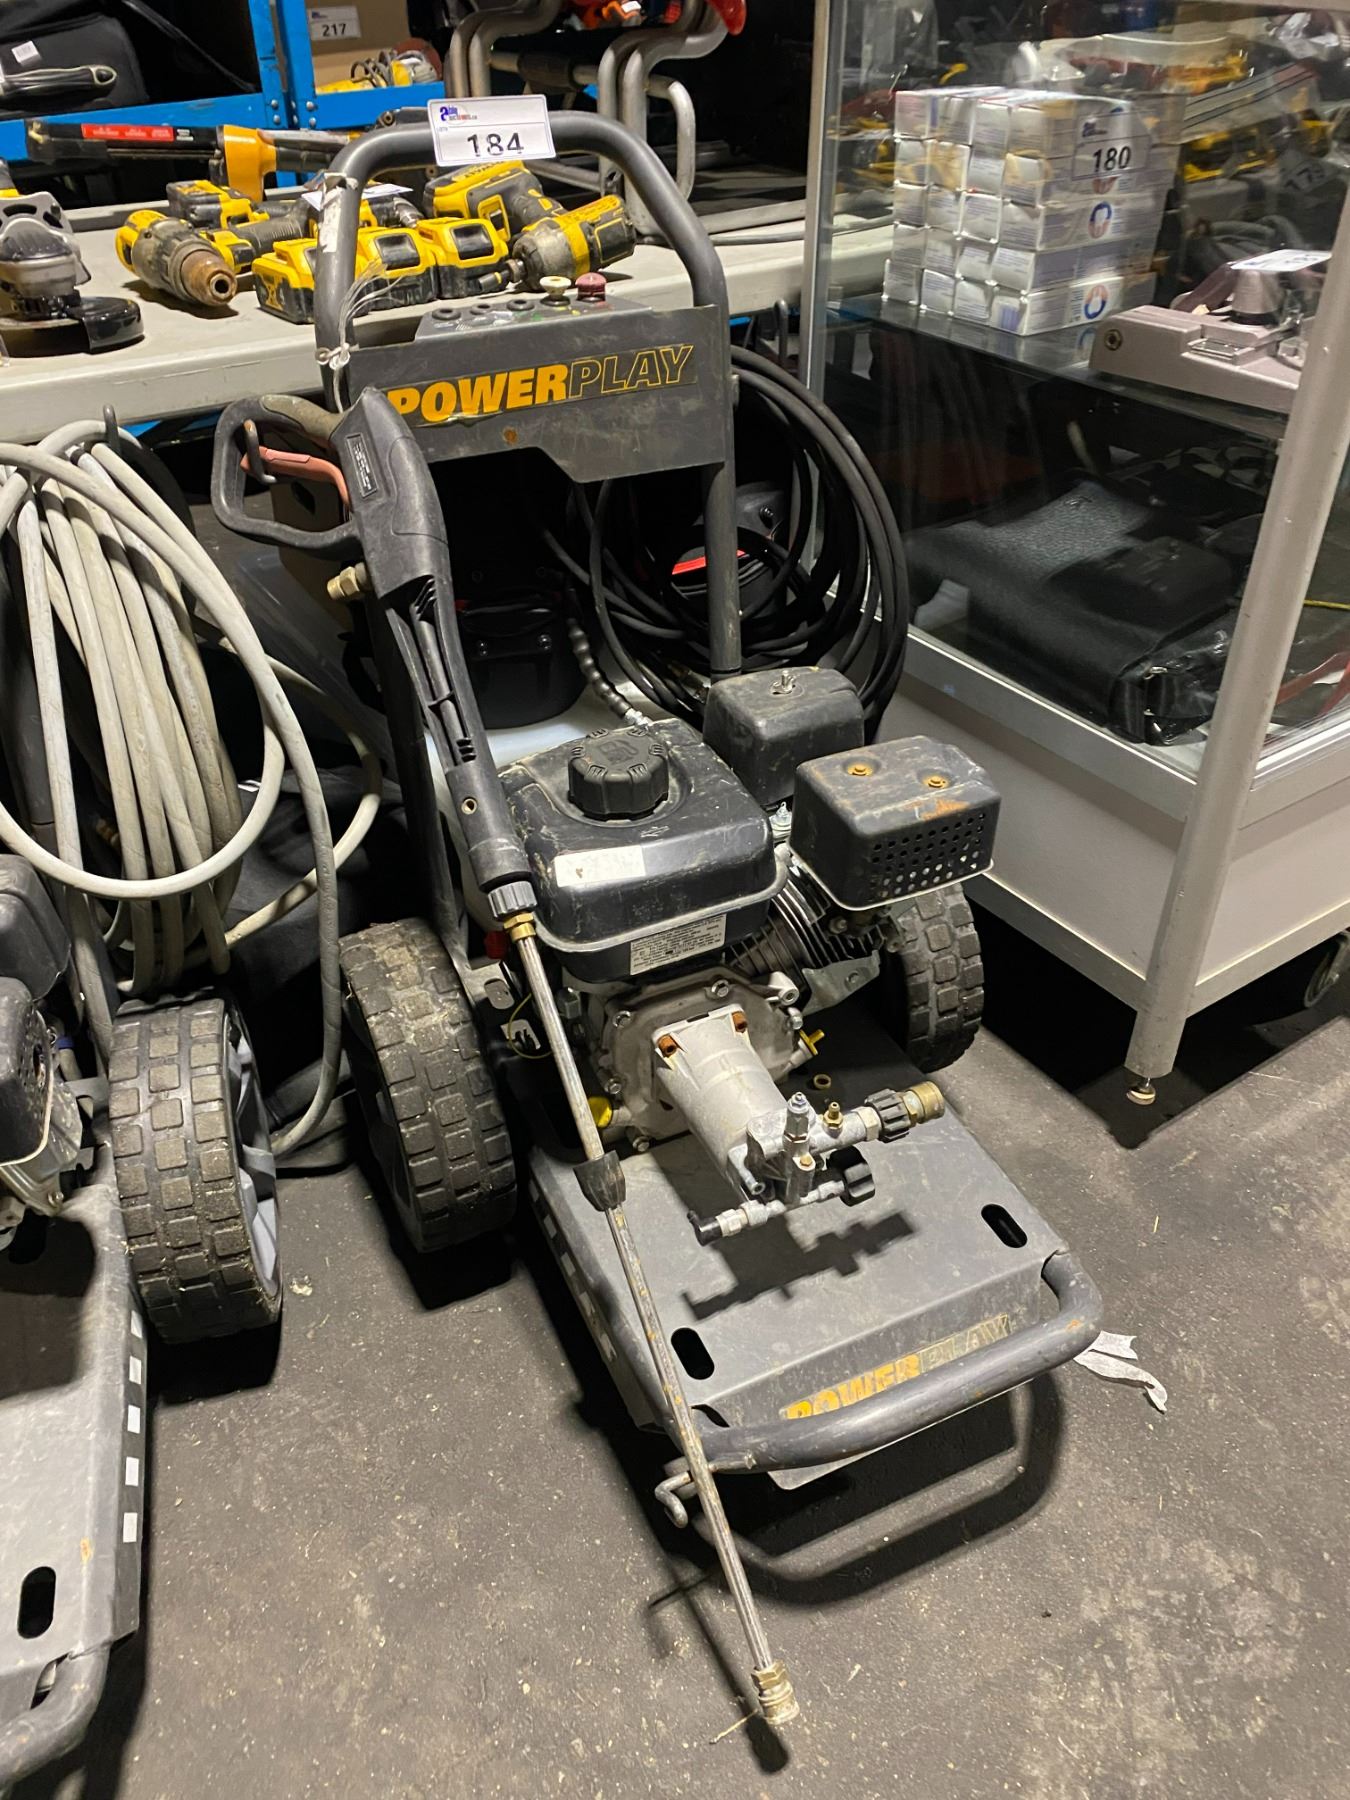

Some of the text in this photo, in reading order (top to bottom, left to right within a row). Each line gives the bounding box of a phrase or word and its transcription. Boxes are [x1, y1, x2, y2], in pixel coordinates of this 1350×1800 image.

[322, 23, 346, 37] 217
[467, 132, 524, 157] 184
[1093, 146, 1132, 173] 180
[386, 344, 694, 423] POWERPLAY
[780, 1313, 1012, 1421] POWERPLAY
